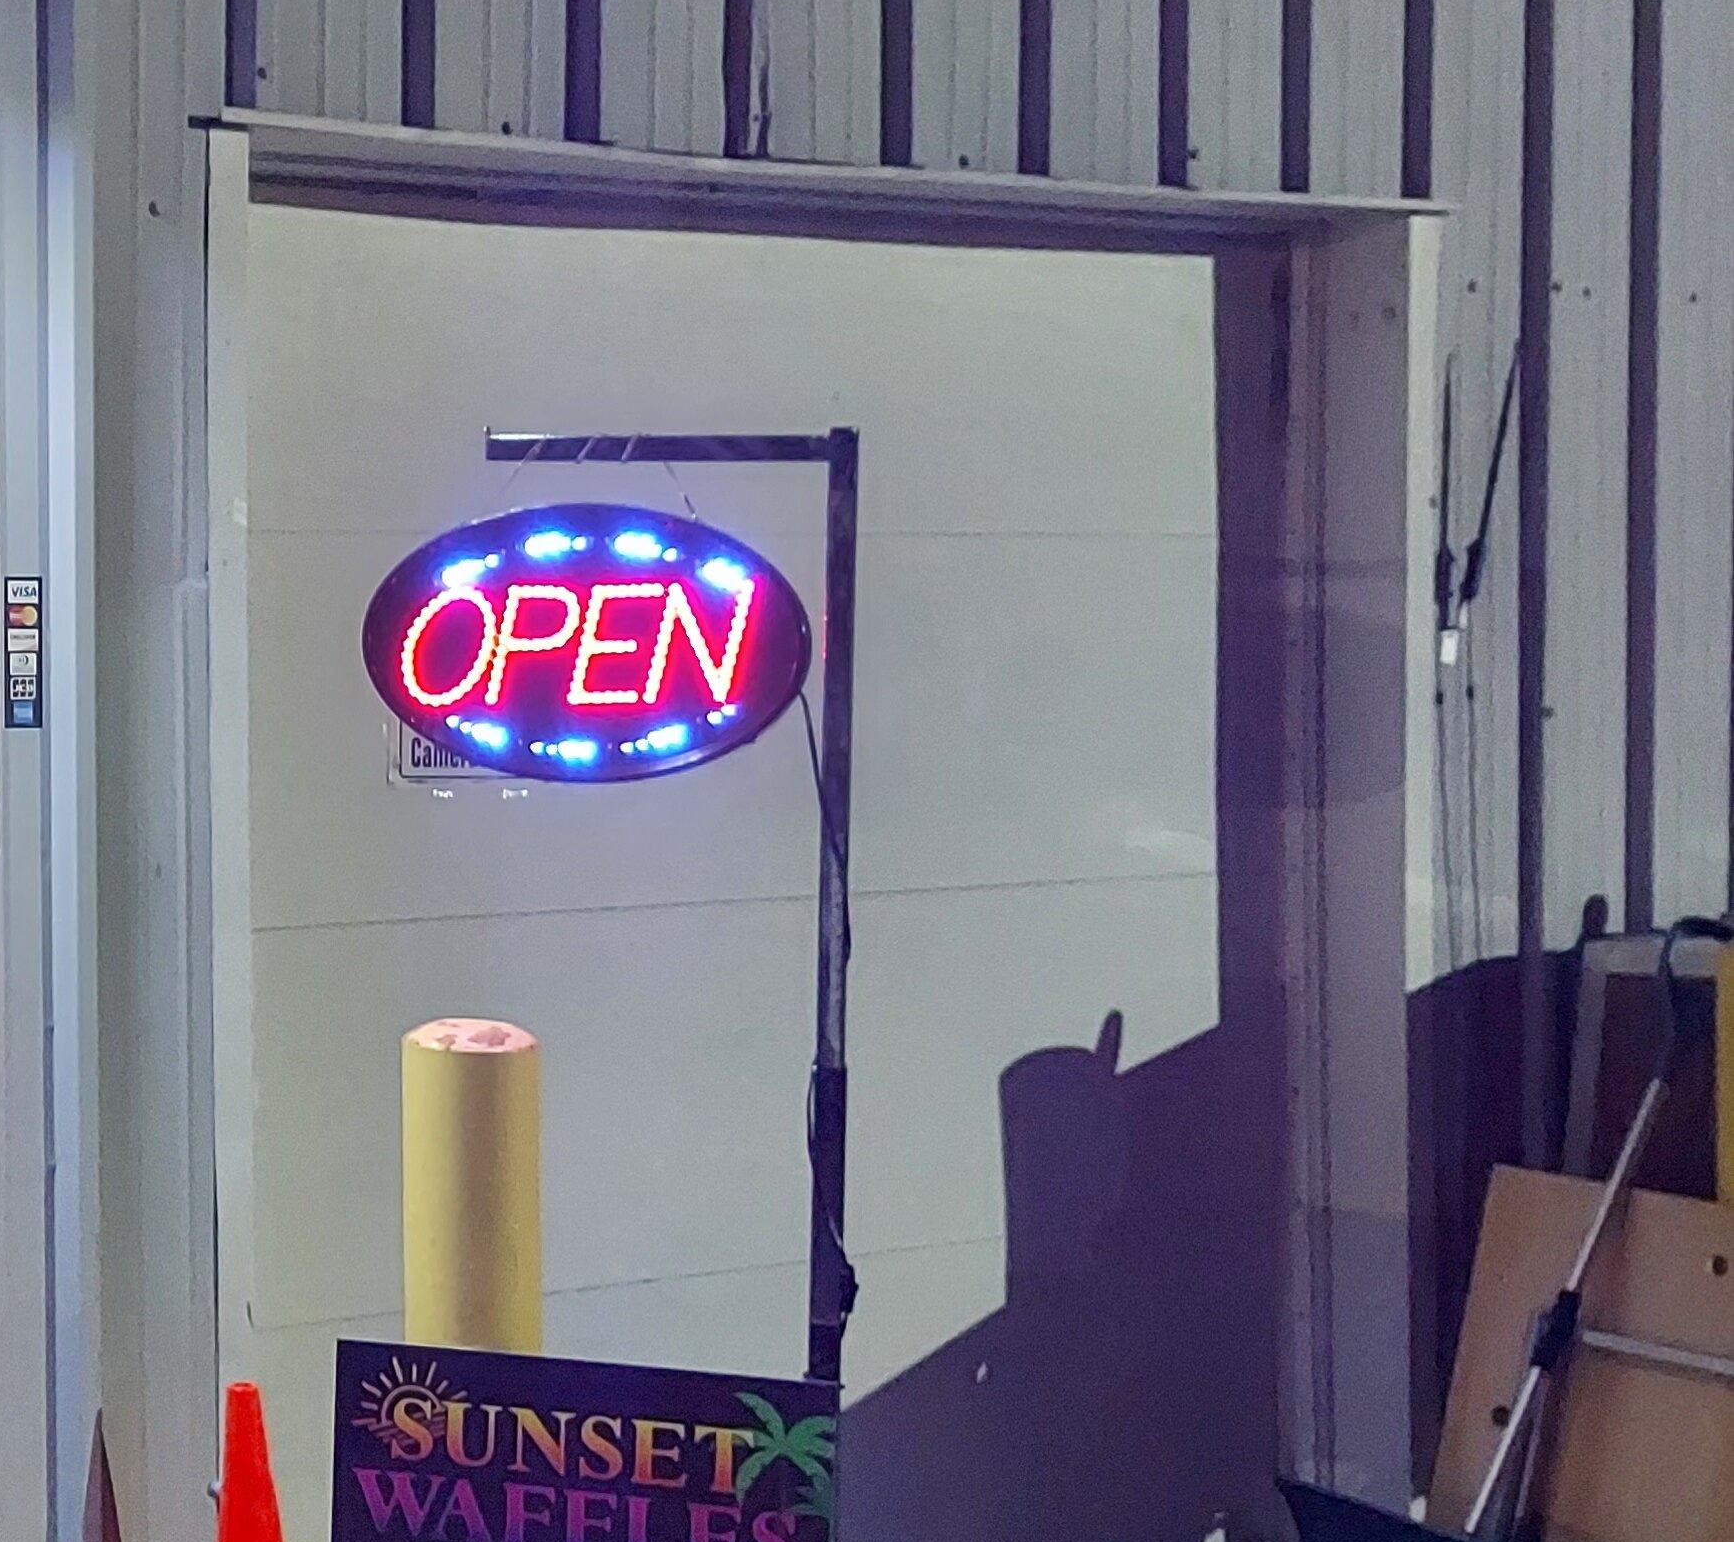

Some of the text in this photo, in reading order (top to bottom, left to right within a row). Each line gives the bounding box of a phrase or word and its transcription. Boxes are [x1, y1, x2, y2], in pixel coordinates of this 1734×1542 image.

[11, 585, 37, 598] VISA
[401, 579, 755, 707] OPEN
[390, 1396, 755, 1494] SUNSET
